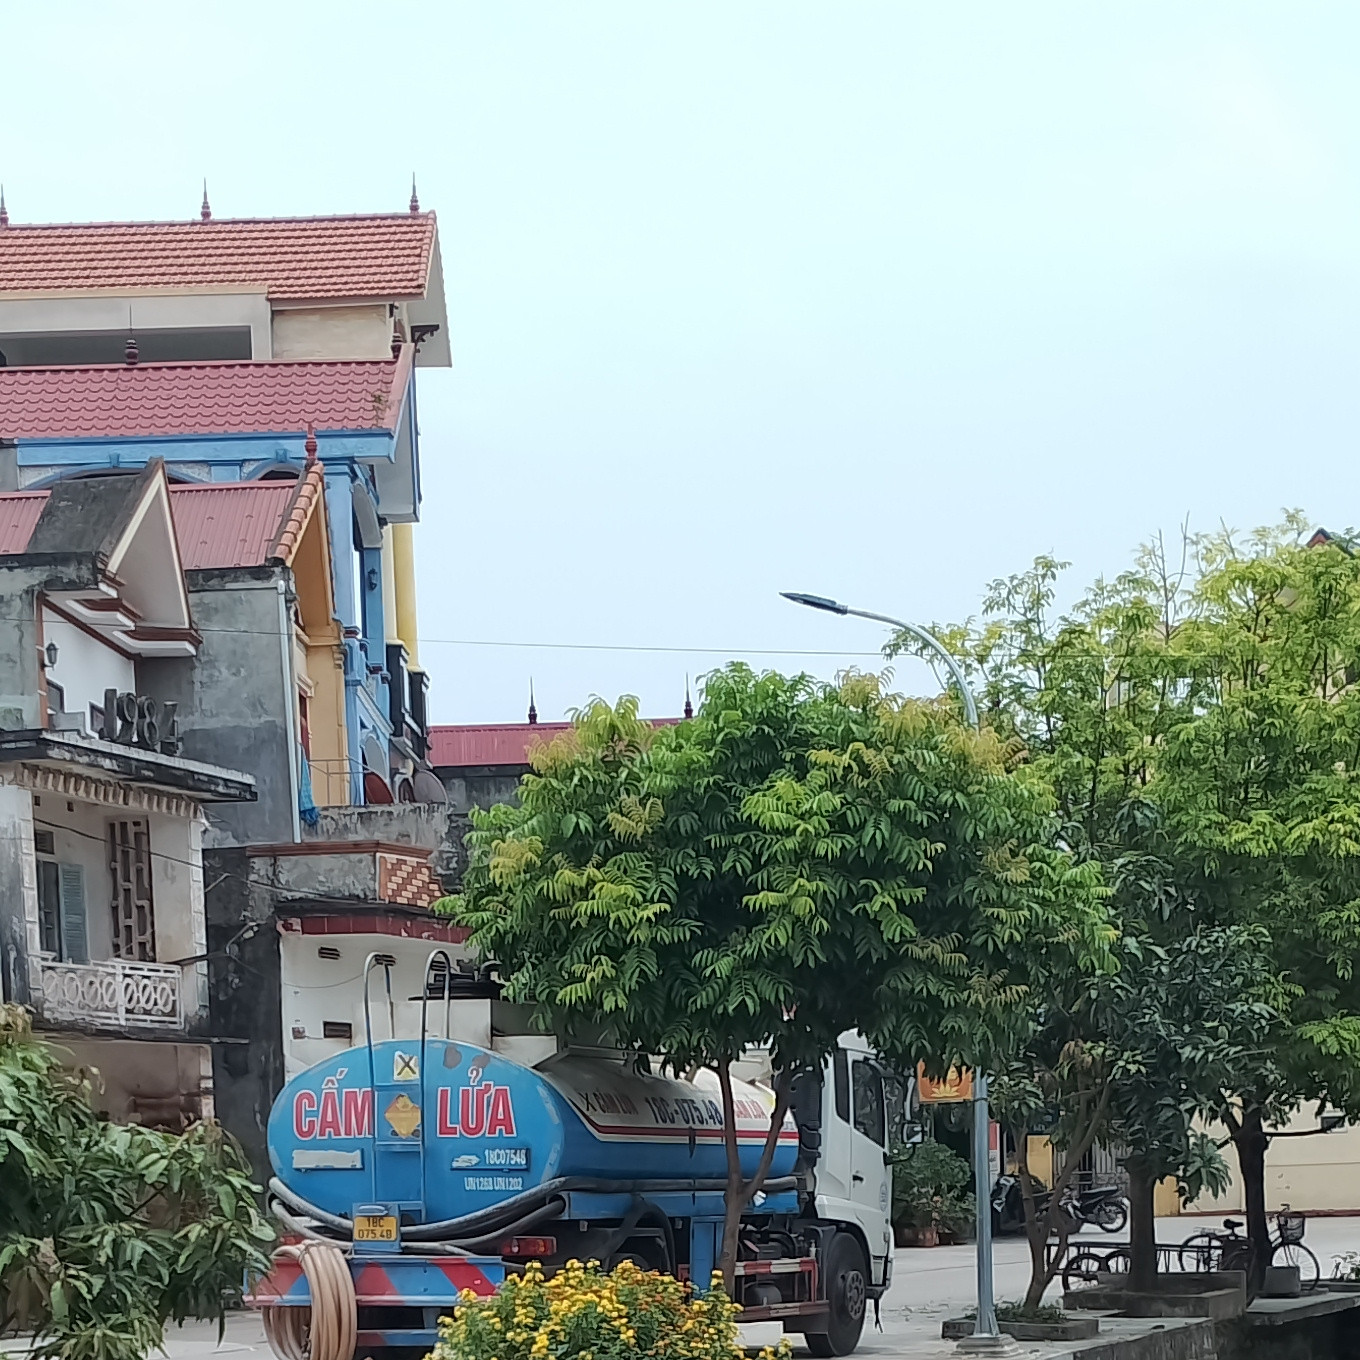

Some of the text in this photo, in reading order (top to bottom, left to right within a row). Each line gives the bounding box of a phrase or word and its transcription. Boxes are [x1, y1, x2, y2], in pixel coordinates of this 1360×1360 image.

[294, 1066, 518, 1140] CẤM LỬA
[366, 1216, 384, 1228] 18C
